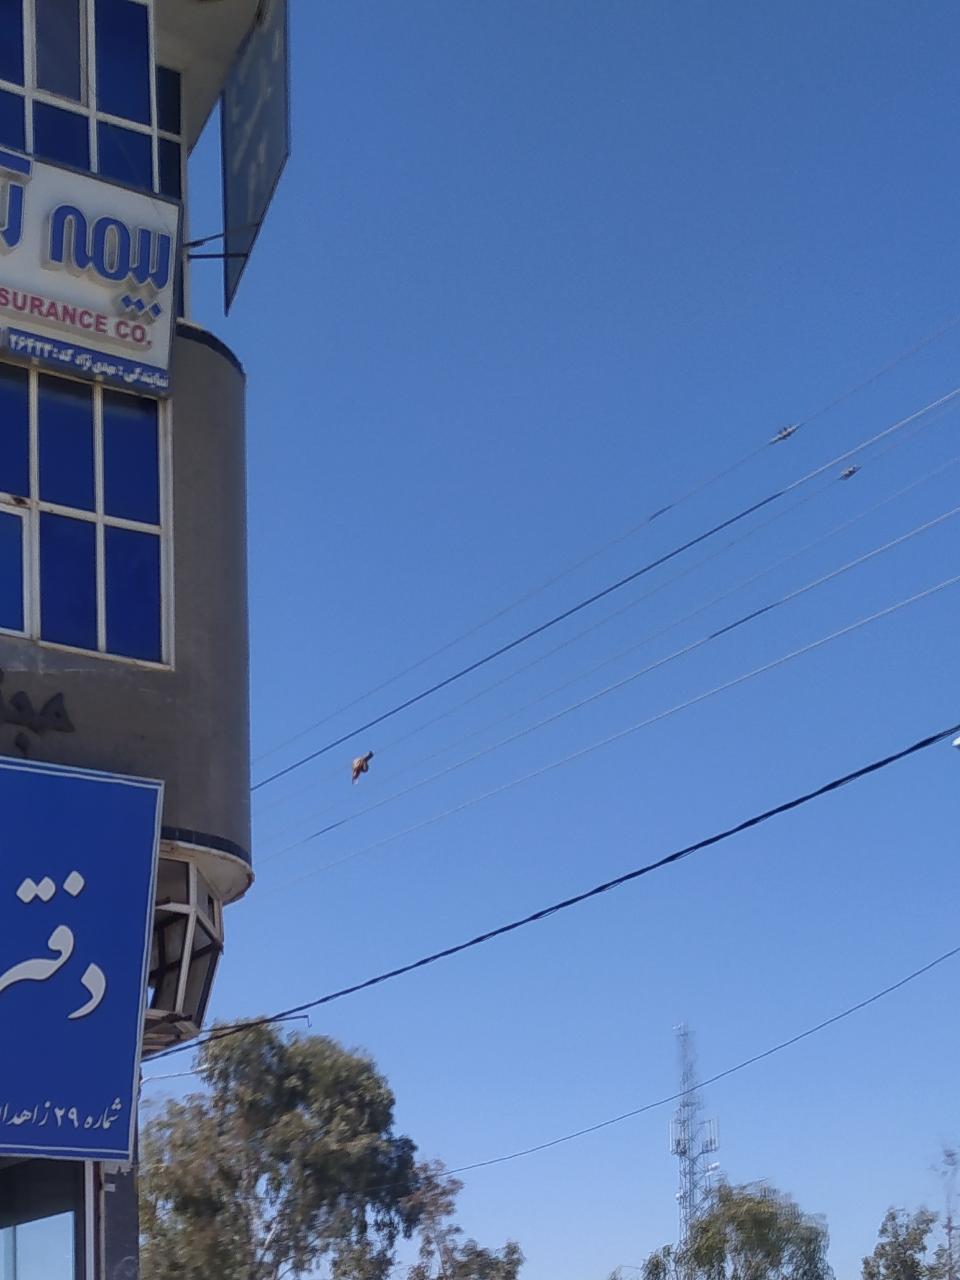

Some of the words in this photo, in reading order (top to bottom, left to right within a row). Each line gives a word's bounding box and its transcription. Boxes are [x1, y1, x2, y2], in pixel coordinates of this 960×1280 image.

[49, 204, 172, 318] بیمه
[115, 319, 152, 346] CO.
[54, 1107, 79, 1128] ۲۹
[83, 1096, 123, 1129] شماره
